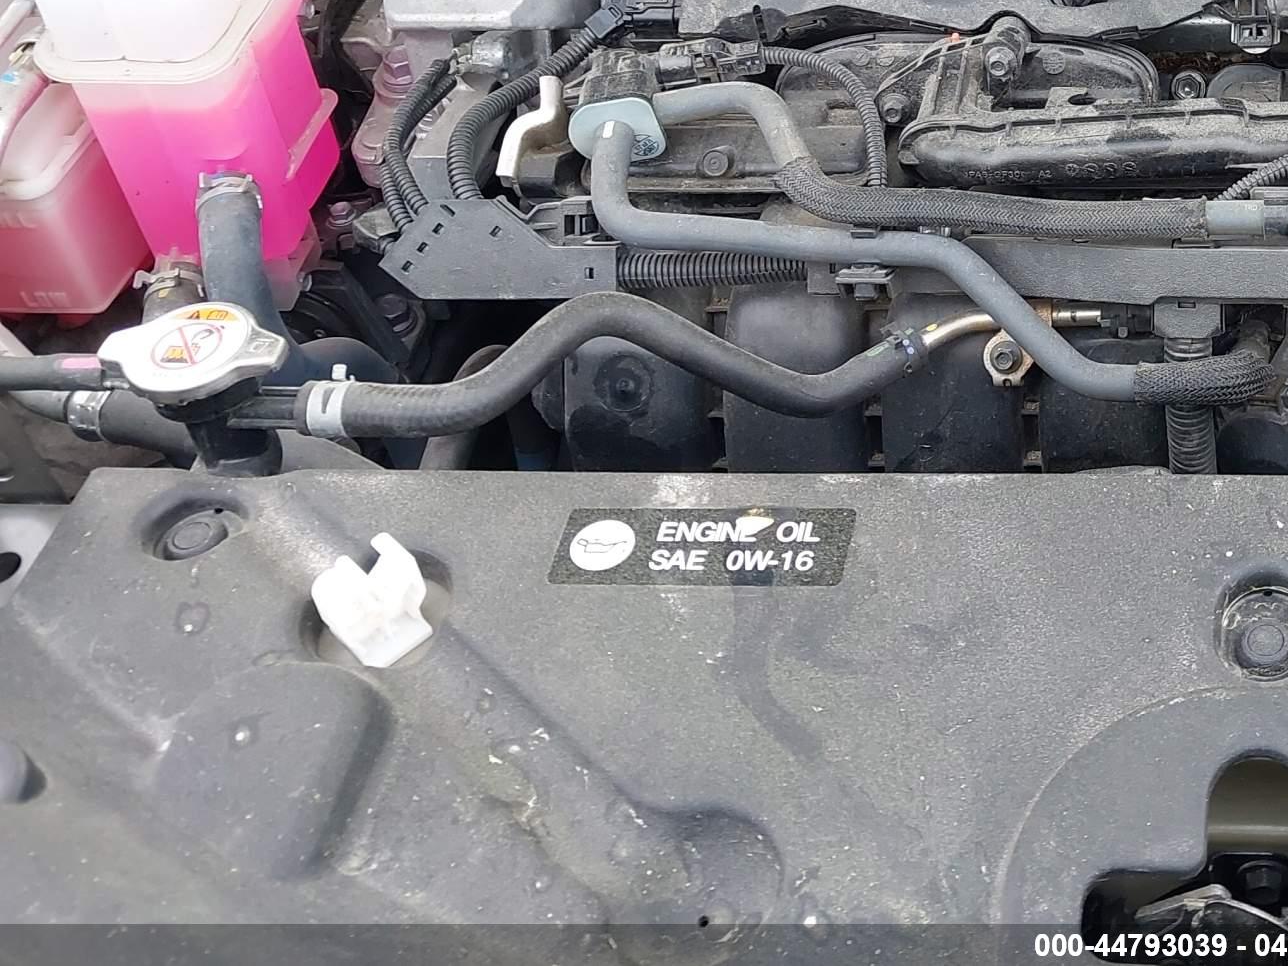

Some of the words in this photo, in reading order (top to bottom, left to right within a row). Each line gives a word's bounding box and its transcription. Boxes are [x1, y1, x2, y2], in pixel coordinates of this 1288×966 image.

[776, 521, 821, 543] OIL
[648, 549, 710, 572] SAE
[725, 549, 815, 572] 0W-16
